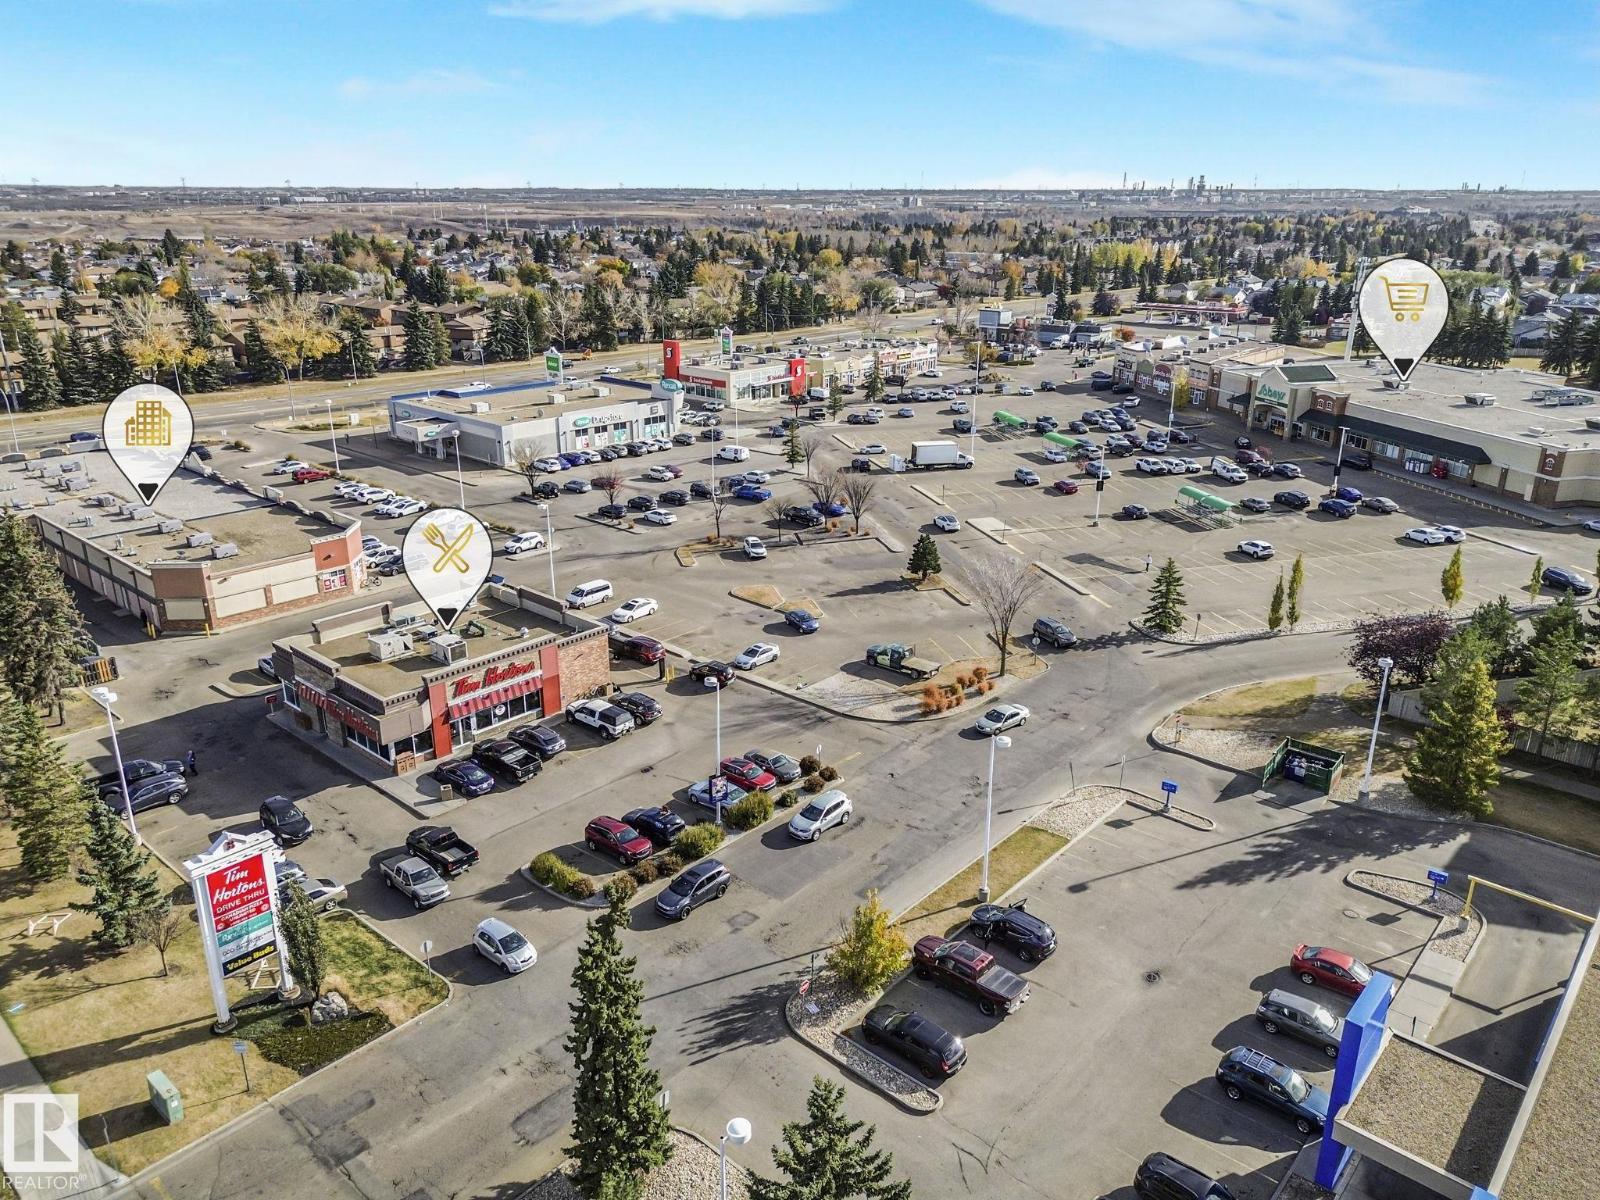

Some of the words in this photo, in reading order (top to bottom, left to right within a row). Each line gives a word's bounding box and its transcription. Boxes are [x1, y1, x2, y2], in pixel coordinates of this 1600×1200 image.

[451, 674, 481, 697] Tim
[482, 661, 535, 688] Hortons
[223, 866, 249, 885] Tim
[213, 879, 265, 905] Hortons
[216, 899, 241, 914] DRIVE
[243, 889, 265, 903] THRU
[227, 956, 252, 970] Value
[253, 945, 275, 959] Buds
